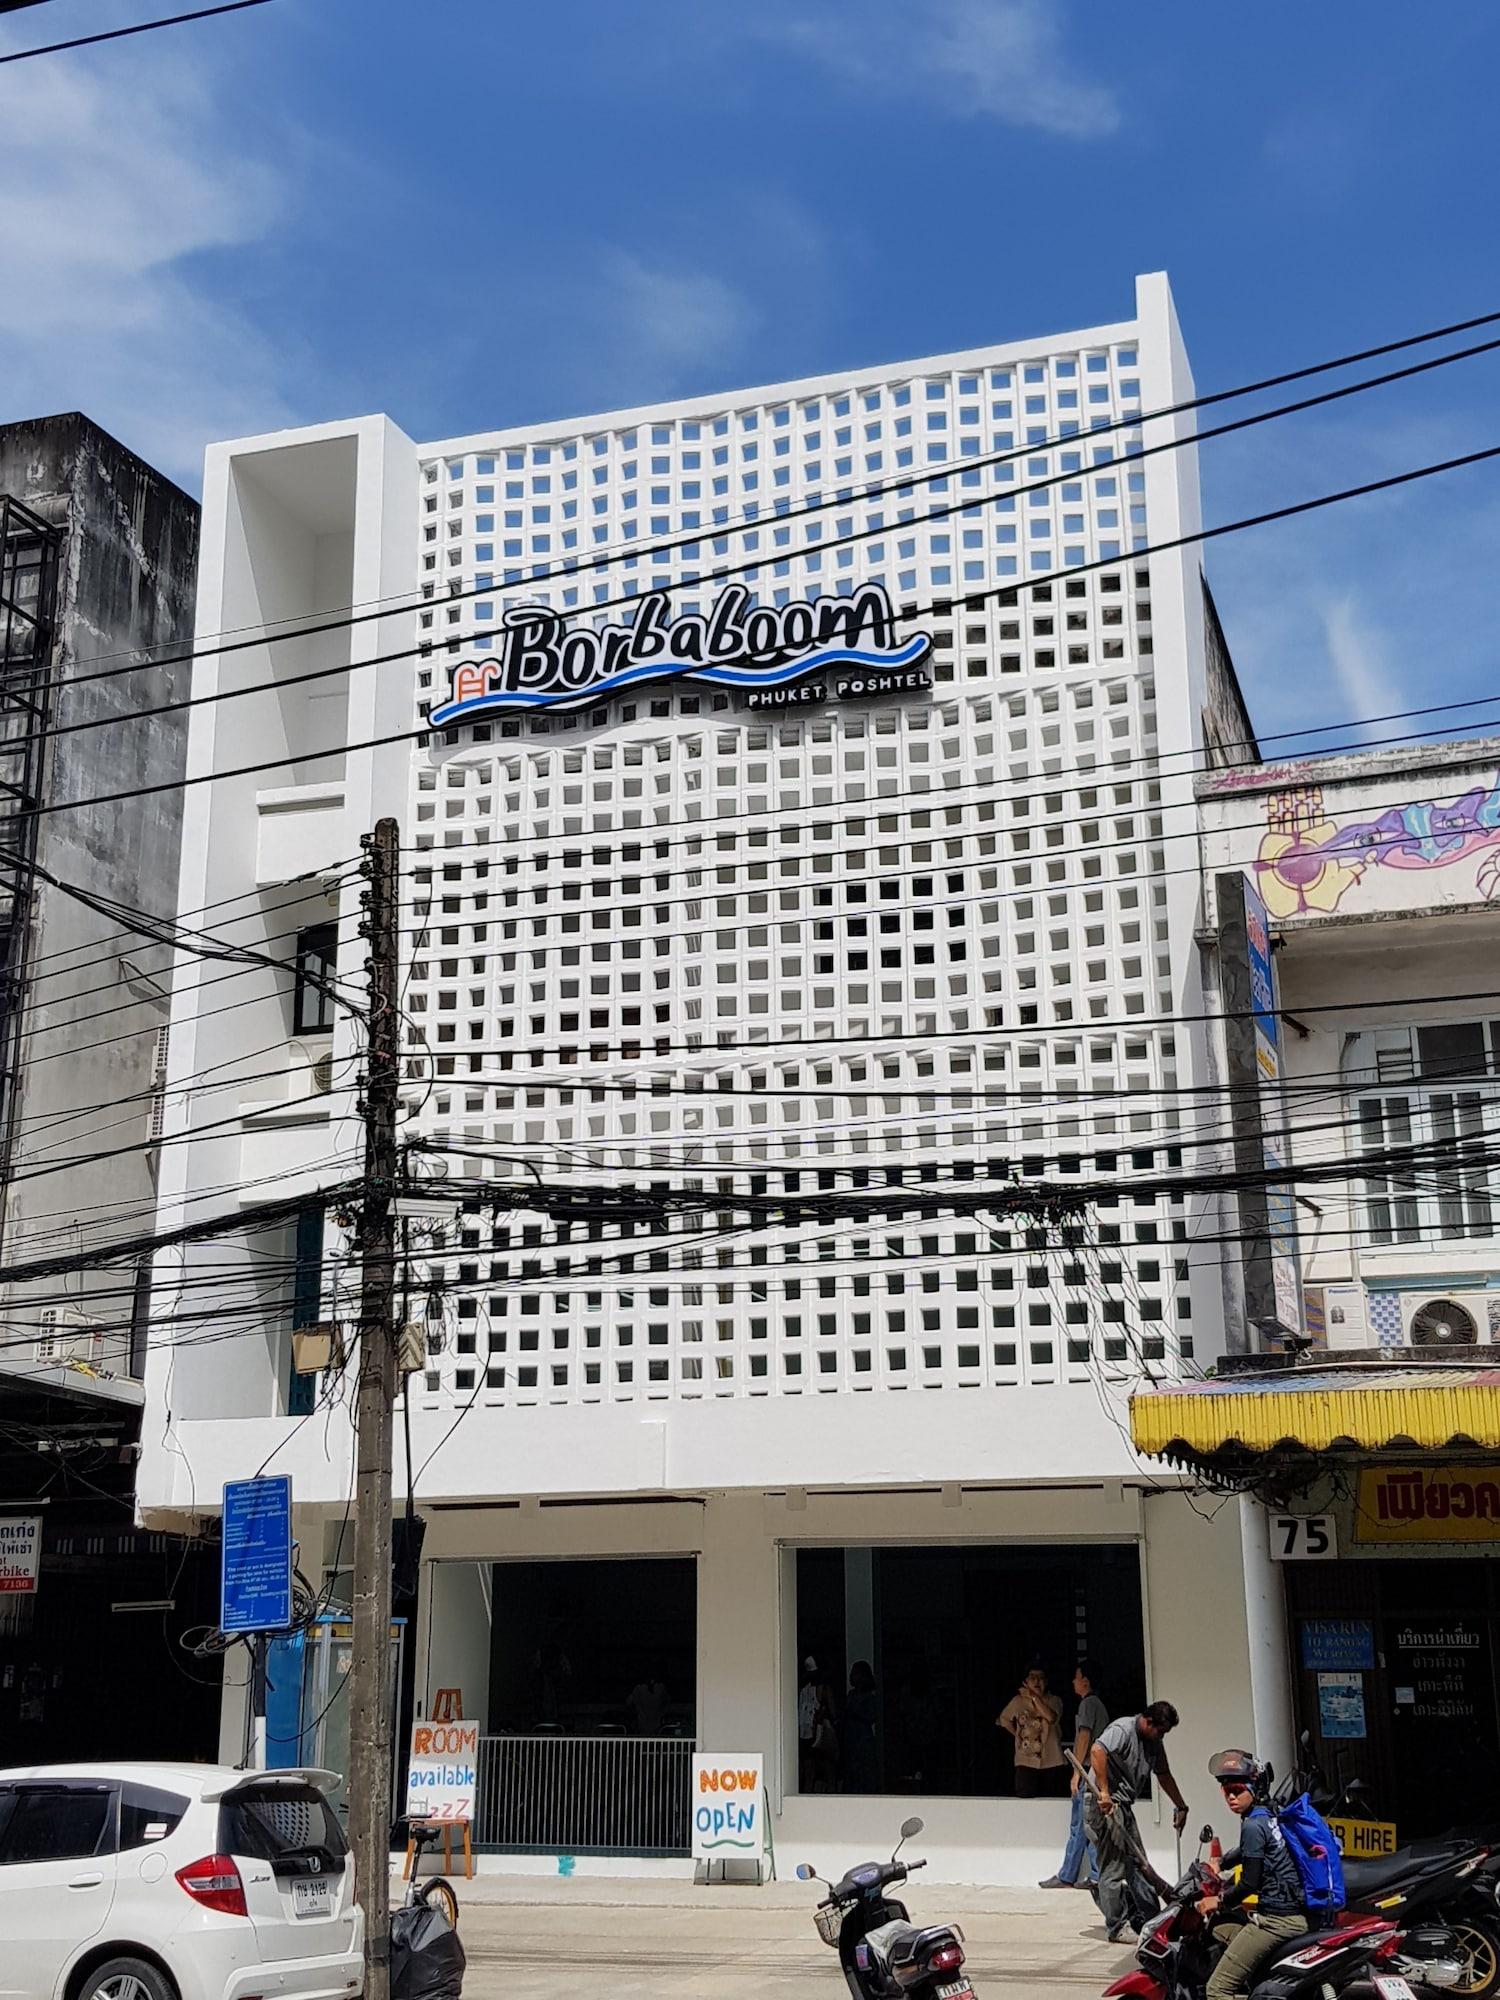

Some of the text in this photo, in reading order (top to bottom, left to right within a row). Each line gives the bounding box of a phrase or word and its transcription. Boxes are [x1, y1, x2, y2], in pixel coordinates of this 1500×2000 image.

[502, 585, 888, 691] Borbaboom
[749, 673, 930, 706] PHUKET POSHTEL
[1278, 1520, 1329, 1554] 75
[1304, 1620, 1370, 1635] VISA RUN
[414, 1727, 477, 1755] ROOM
[411, 1765, 475, 1788] available
[700, 1768, 758, 1793] NOW
[697, 1802, 755, 1837] OPEN
[1354, 1826, 1392, 1852] HIRE
